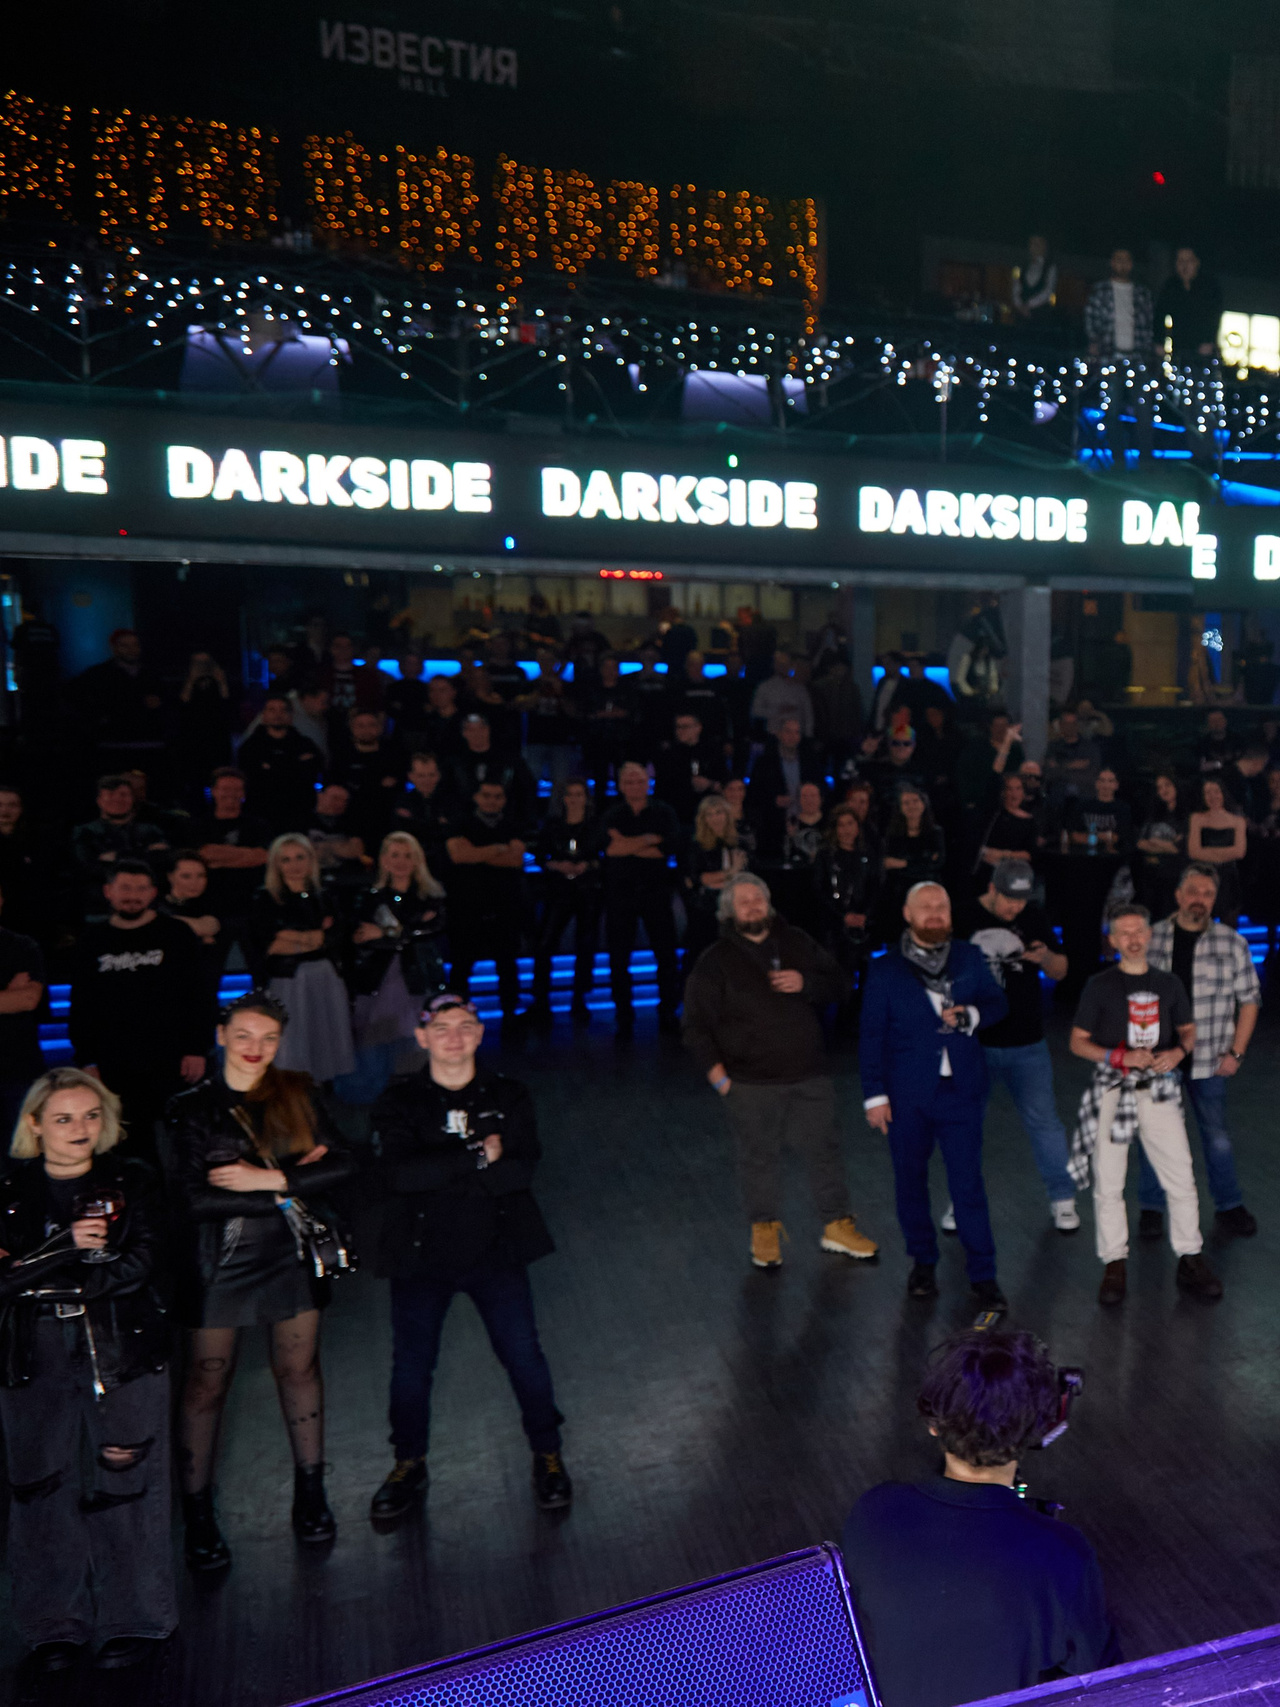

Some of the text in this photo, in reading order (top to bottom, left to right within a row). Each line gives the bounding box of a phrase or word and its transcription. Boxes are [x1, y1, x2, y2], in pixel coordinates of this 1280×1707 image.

[319, 18, 519, 89] ИЗВЕСТИЯ
[167, 444, 492, 514] DARKSIDE
[540, 466, 818, 531] DARKSIDE
[859, 485, 1088, 544] DARKSIDE
